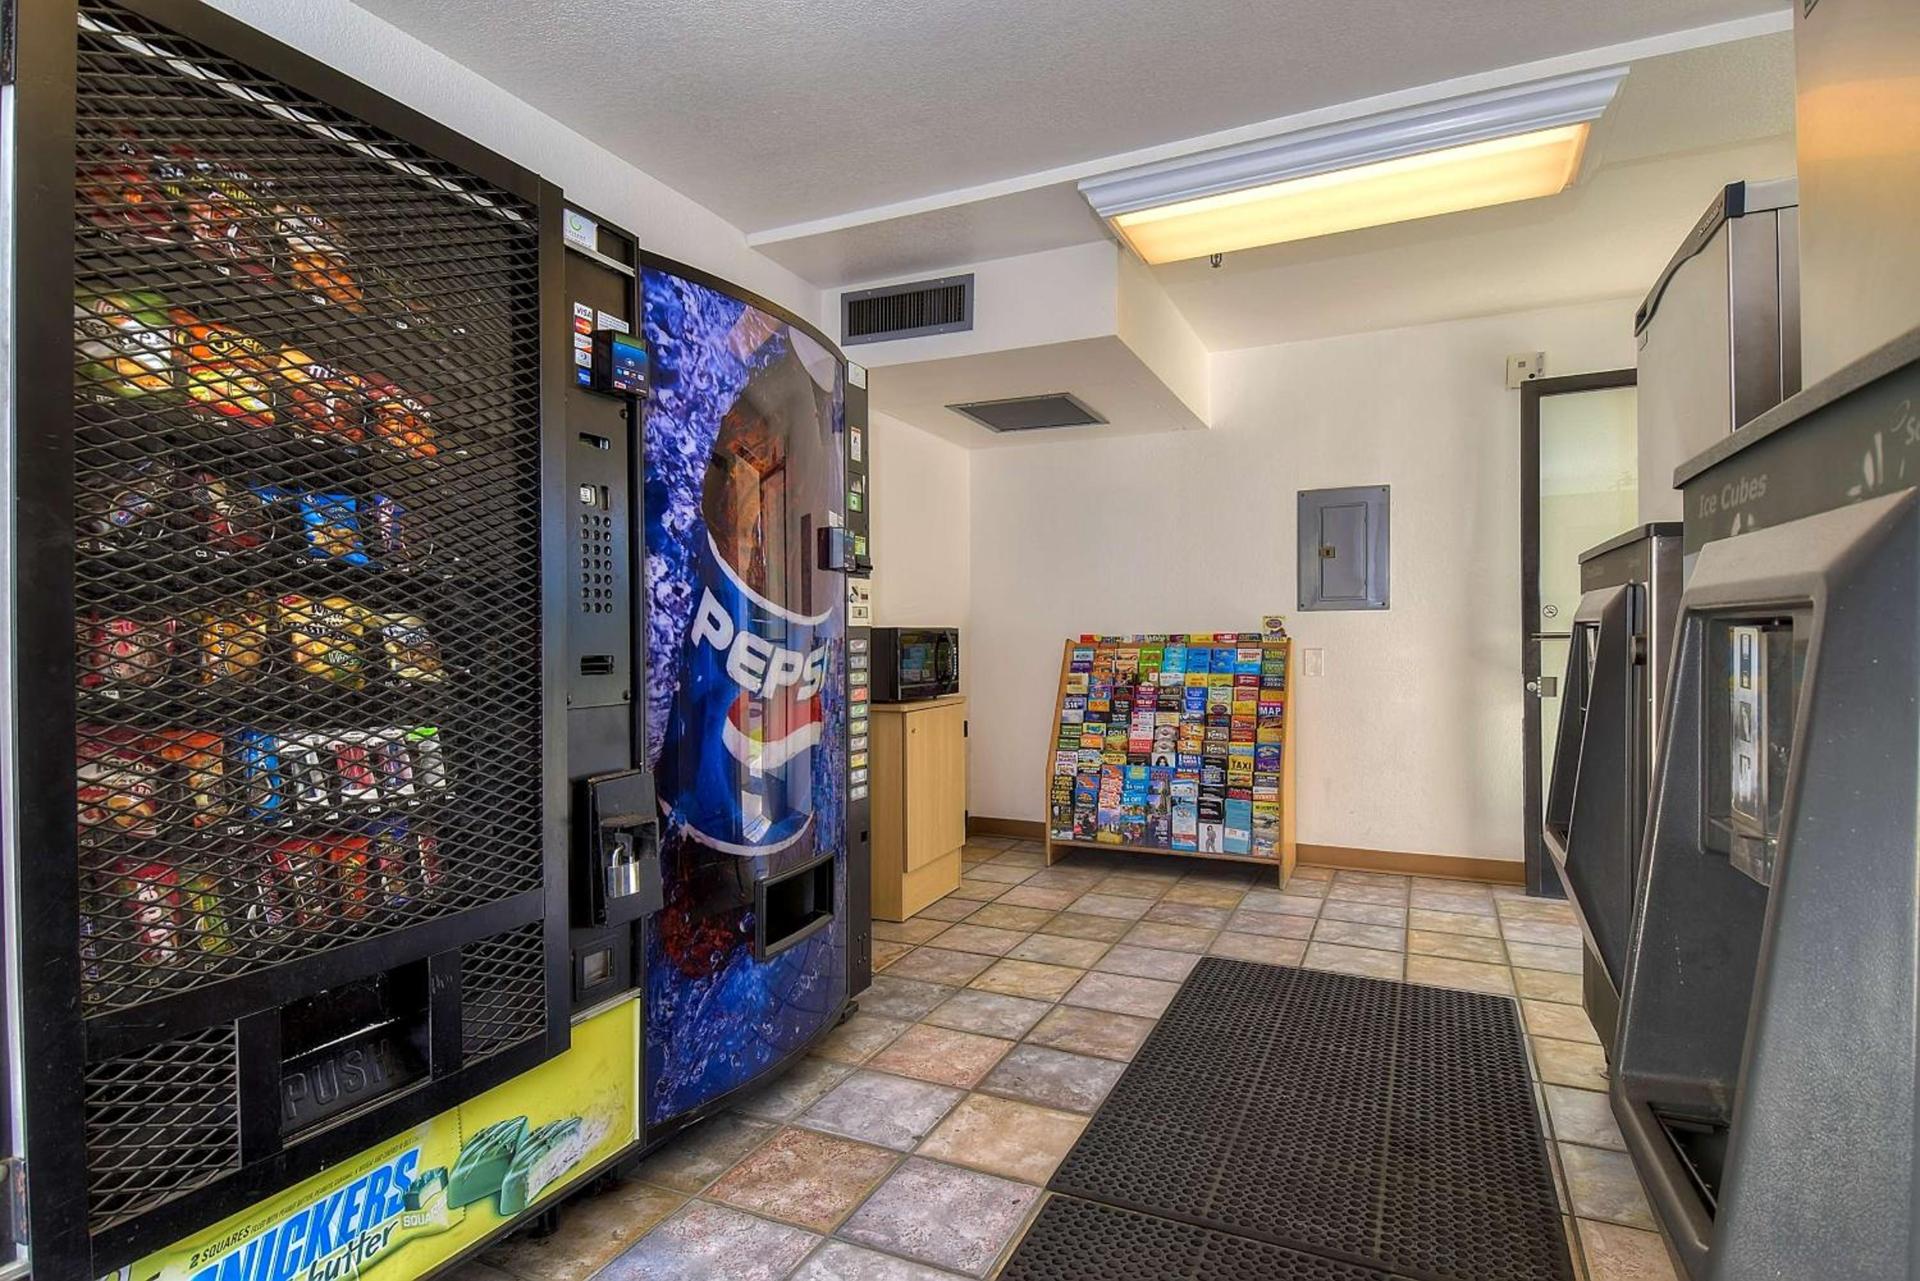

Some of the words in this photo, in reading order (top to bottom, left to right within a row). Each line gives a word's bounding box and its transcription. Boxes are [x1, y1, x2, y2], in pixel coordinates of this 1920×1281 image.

[576, 305, 592, 318] VISA
[1699, 494, 1717, 519] Ice
[1721, 474, 1768, 510] Cubes
[1260, 706, 1281, 716] MAP
[1232, 760, 1252, 770] TAXI
[279, 1039, 391, 1117] PUSH
[189, 1253, 200, 1270] 2
[201, 1224, 251, 1262] SQUARES
[308, 1220, 398, 1281] butter
